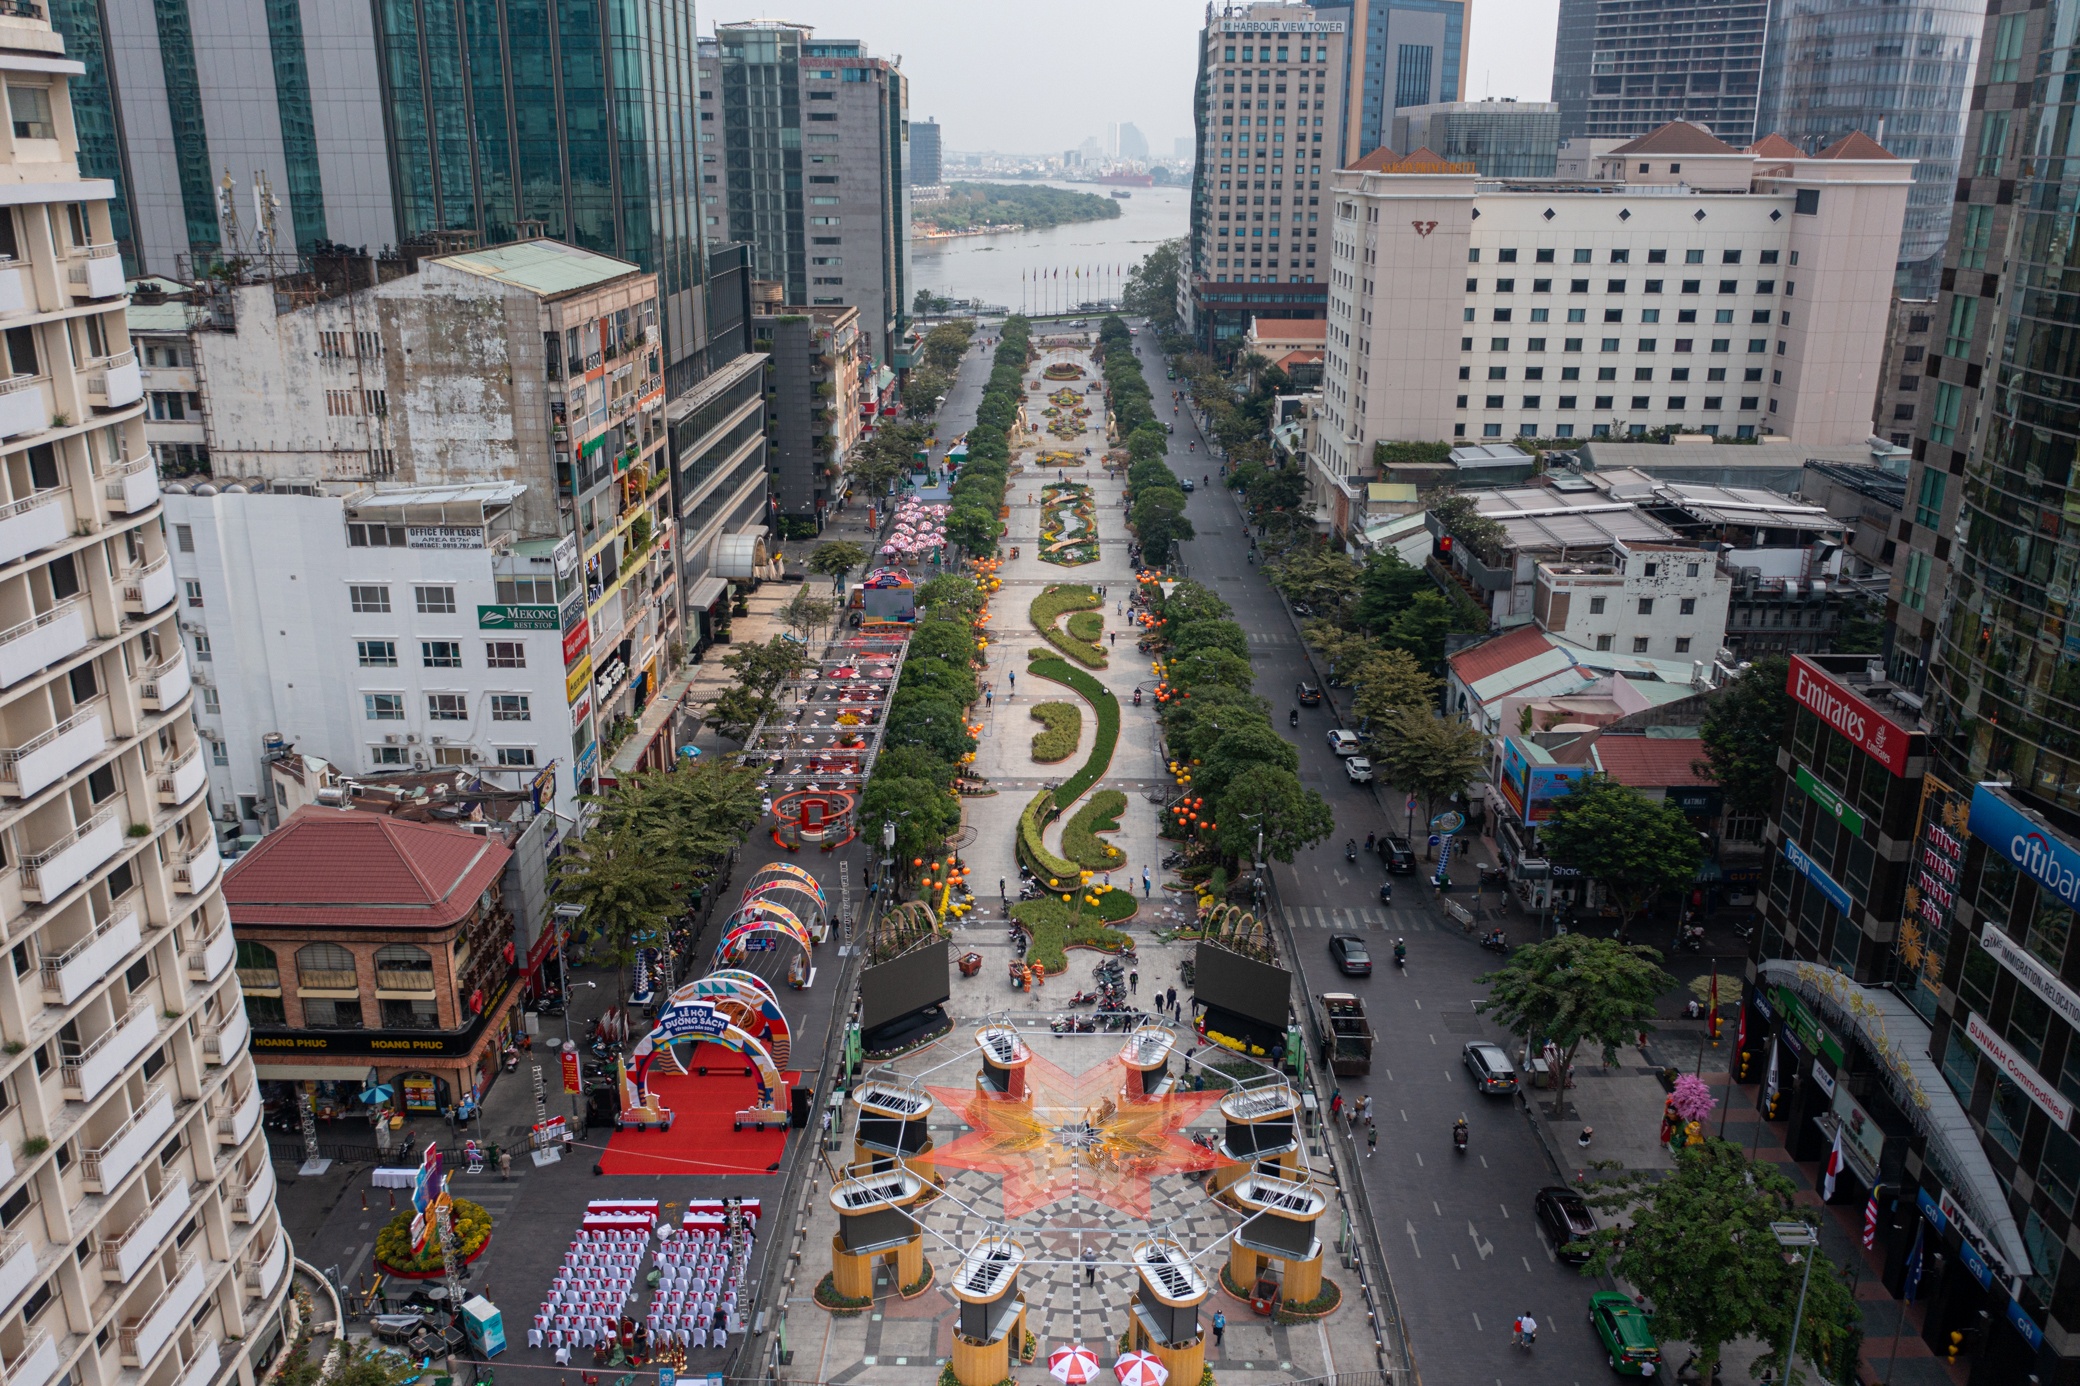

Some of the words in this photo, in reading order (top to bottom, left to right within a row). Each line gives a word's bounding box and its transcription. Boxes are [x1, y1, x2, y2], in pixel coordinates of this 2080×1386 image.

[1233, 22, 1279, 32] HARBOUR
[1282, 22, 1306, 32] VIEW
[1309, 22, 1342, 32] TOWER
[410, 528, 438, 536] OFFICE
[440, 528, 455, 536] FOR
[457, 528, 481, 537] LEASE
[1796, 668, 1866, 742] Emirates
[1866, 739, 1890, 764] Emirates
[679, 1007, 689, 1017] LỄ
[691, 1008, 707, 1018] HỘI
[700, 1017, 725, 1029] SÁCH
[255, 1038, 294, 1047] HOANG
[296, 1039, 327, 1048] PHUC
[371, 1040, 410, 1049] HOANG
[413, 1041, 443, 1049] PHUC
[1969, 1022, 2007, 1064] SUNWAH
[2007, 1059, 2064, 1120] Commodities
